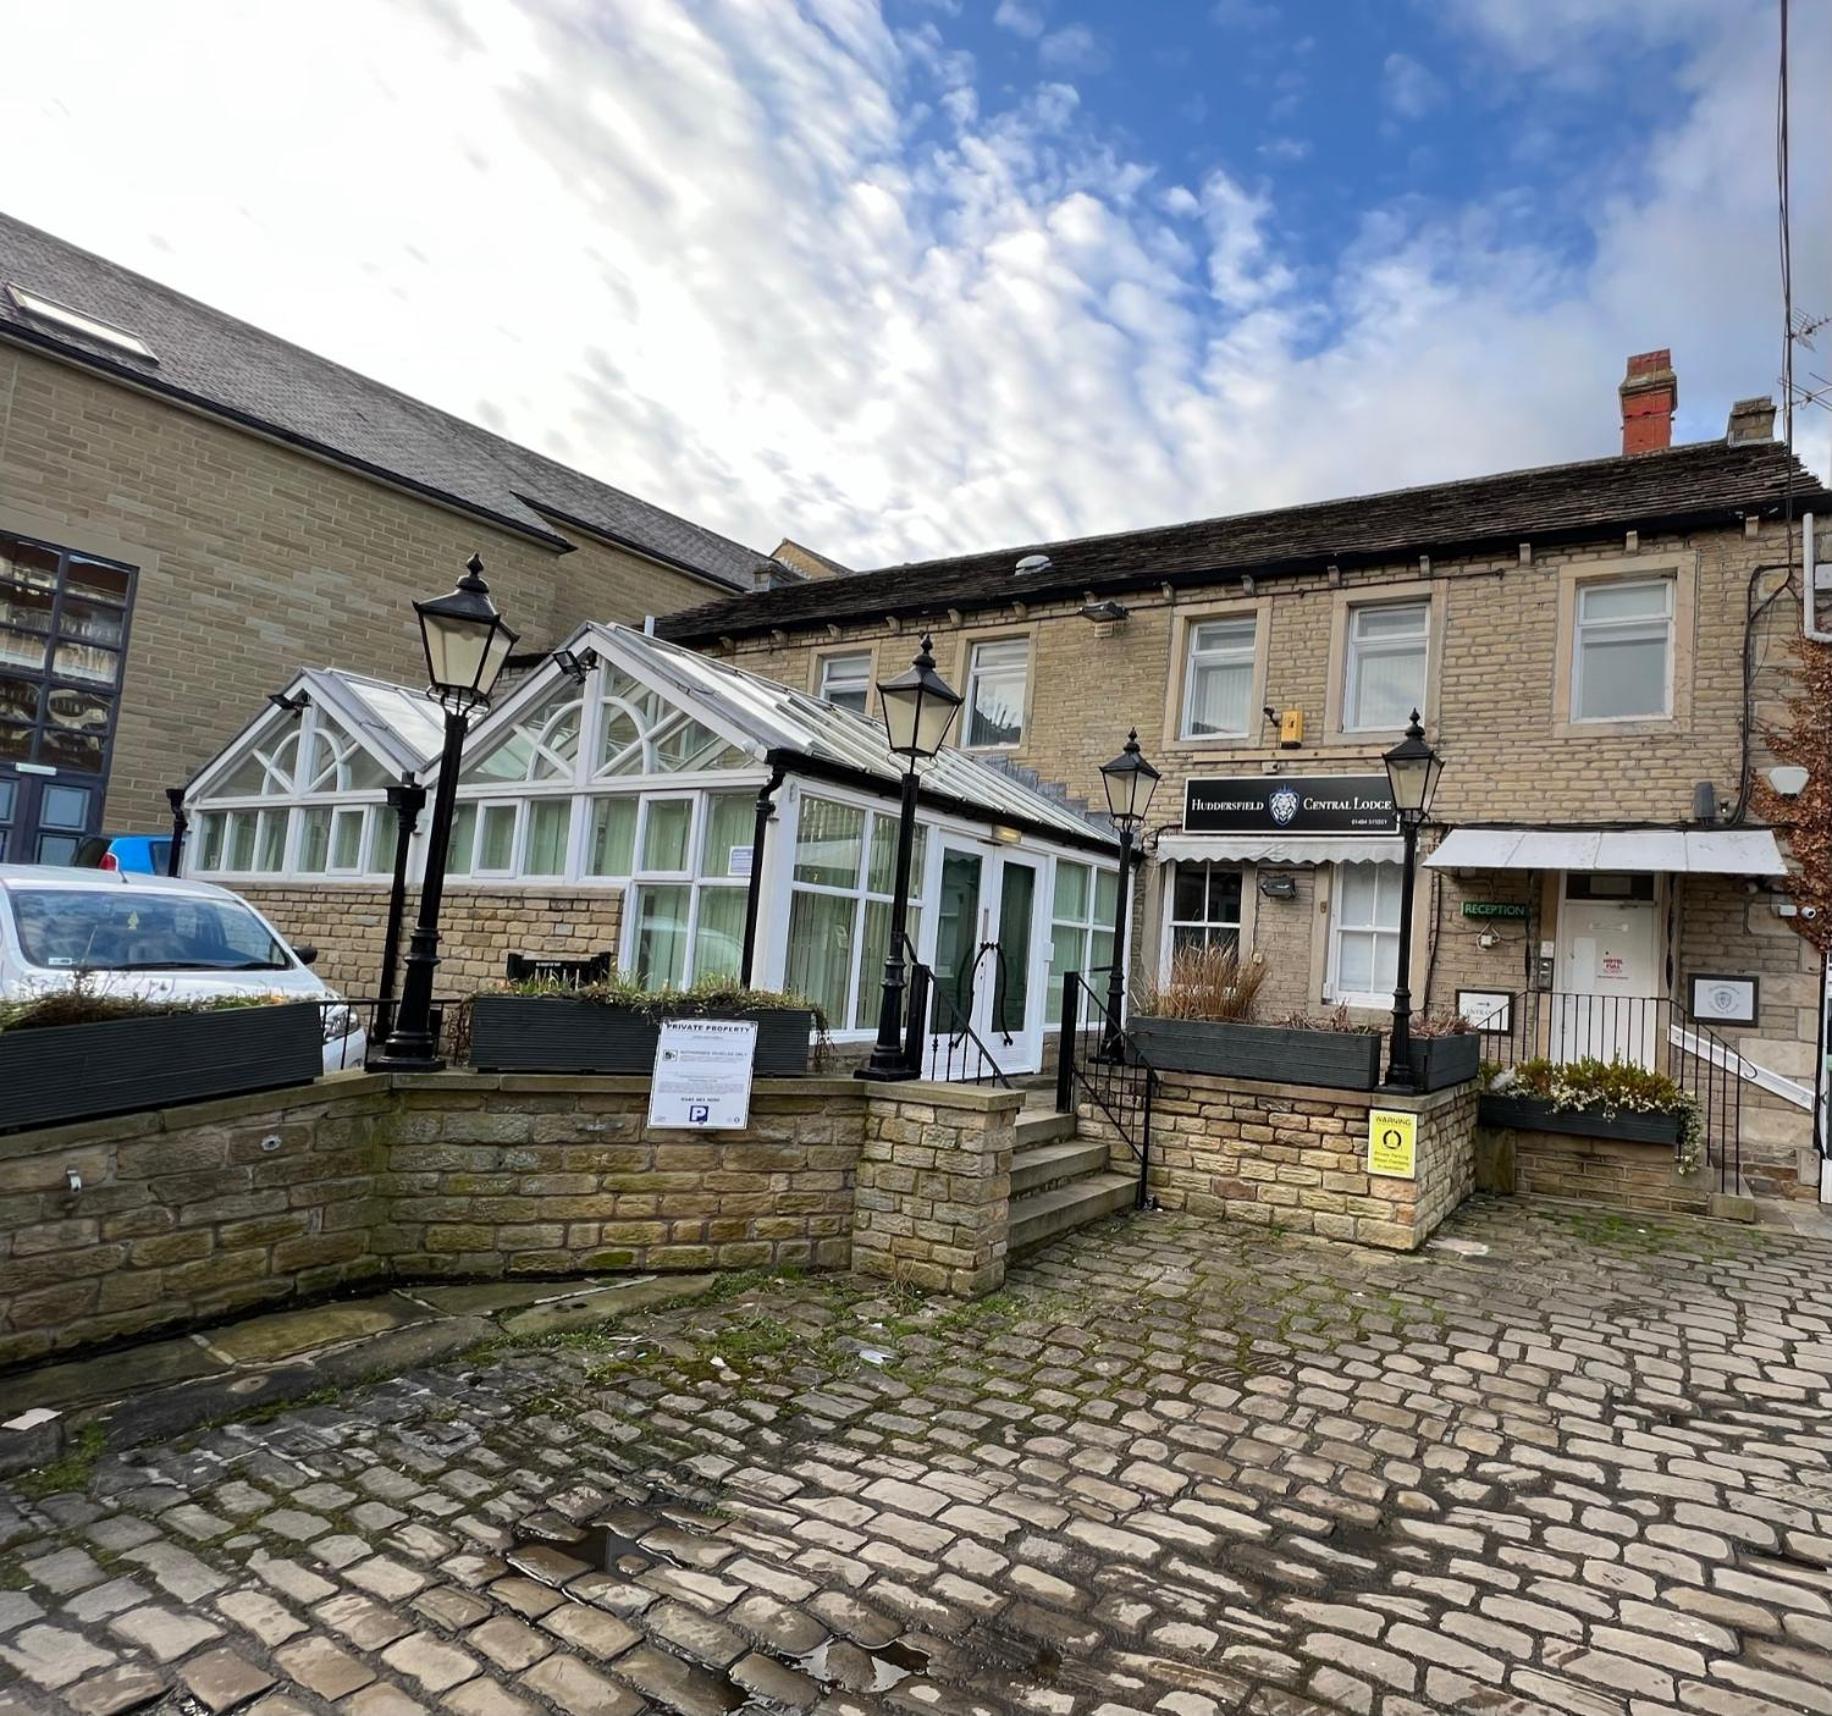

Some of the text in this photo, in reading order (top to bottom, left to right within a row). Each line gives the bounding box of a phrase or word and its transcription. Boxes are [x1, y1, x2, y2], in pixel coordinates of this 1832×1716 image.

[1303, 797, 1352, 811] CENTRAL
[1353, 796, 1392, 811] LODGE
[1464, 903, 1525, 916] RECEPTION
[706, 1025, 751, 1033] PROPERTY
[1375, 1116, 1412, 1126] WARNING
